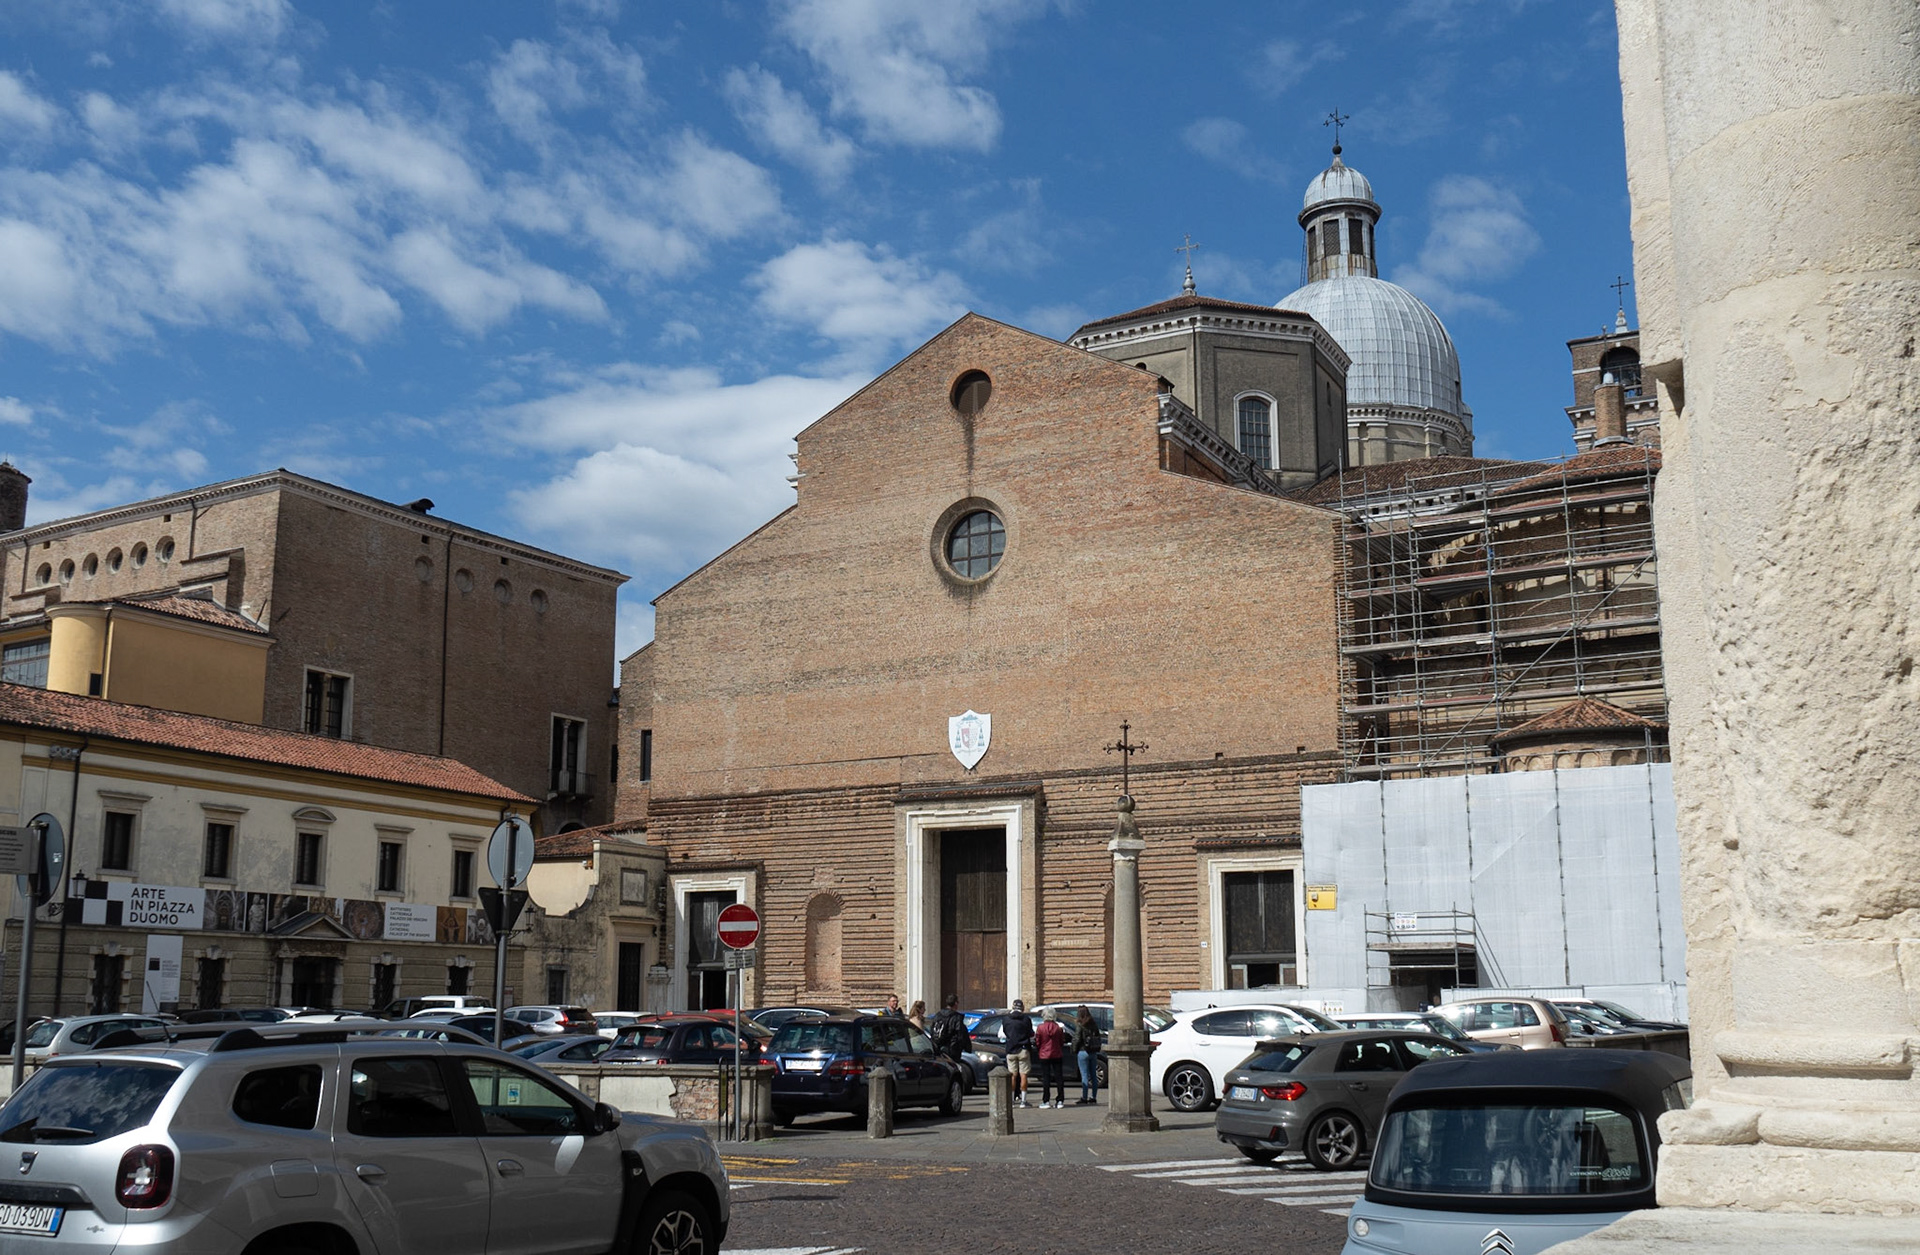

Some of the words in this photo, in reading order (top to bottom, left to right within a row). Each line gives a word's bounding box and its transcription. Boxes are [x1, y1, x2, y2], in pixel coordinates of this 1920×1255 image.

[131, 887, 165, 900] ARTE
[130, 900, 144, 911] IN
[148, 901, 195, 914] PIAZZA
[129, 911, 179, 925] DUOMO
[12, 1206, 54, 1229] 039DW
